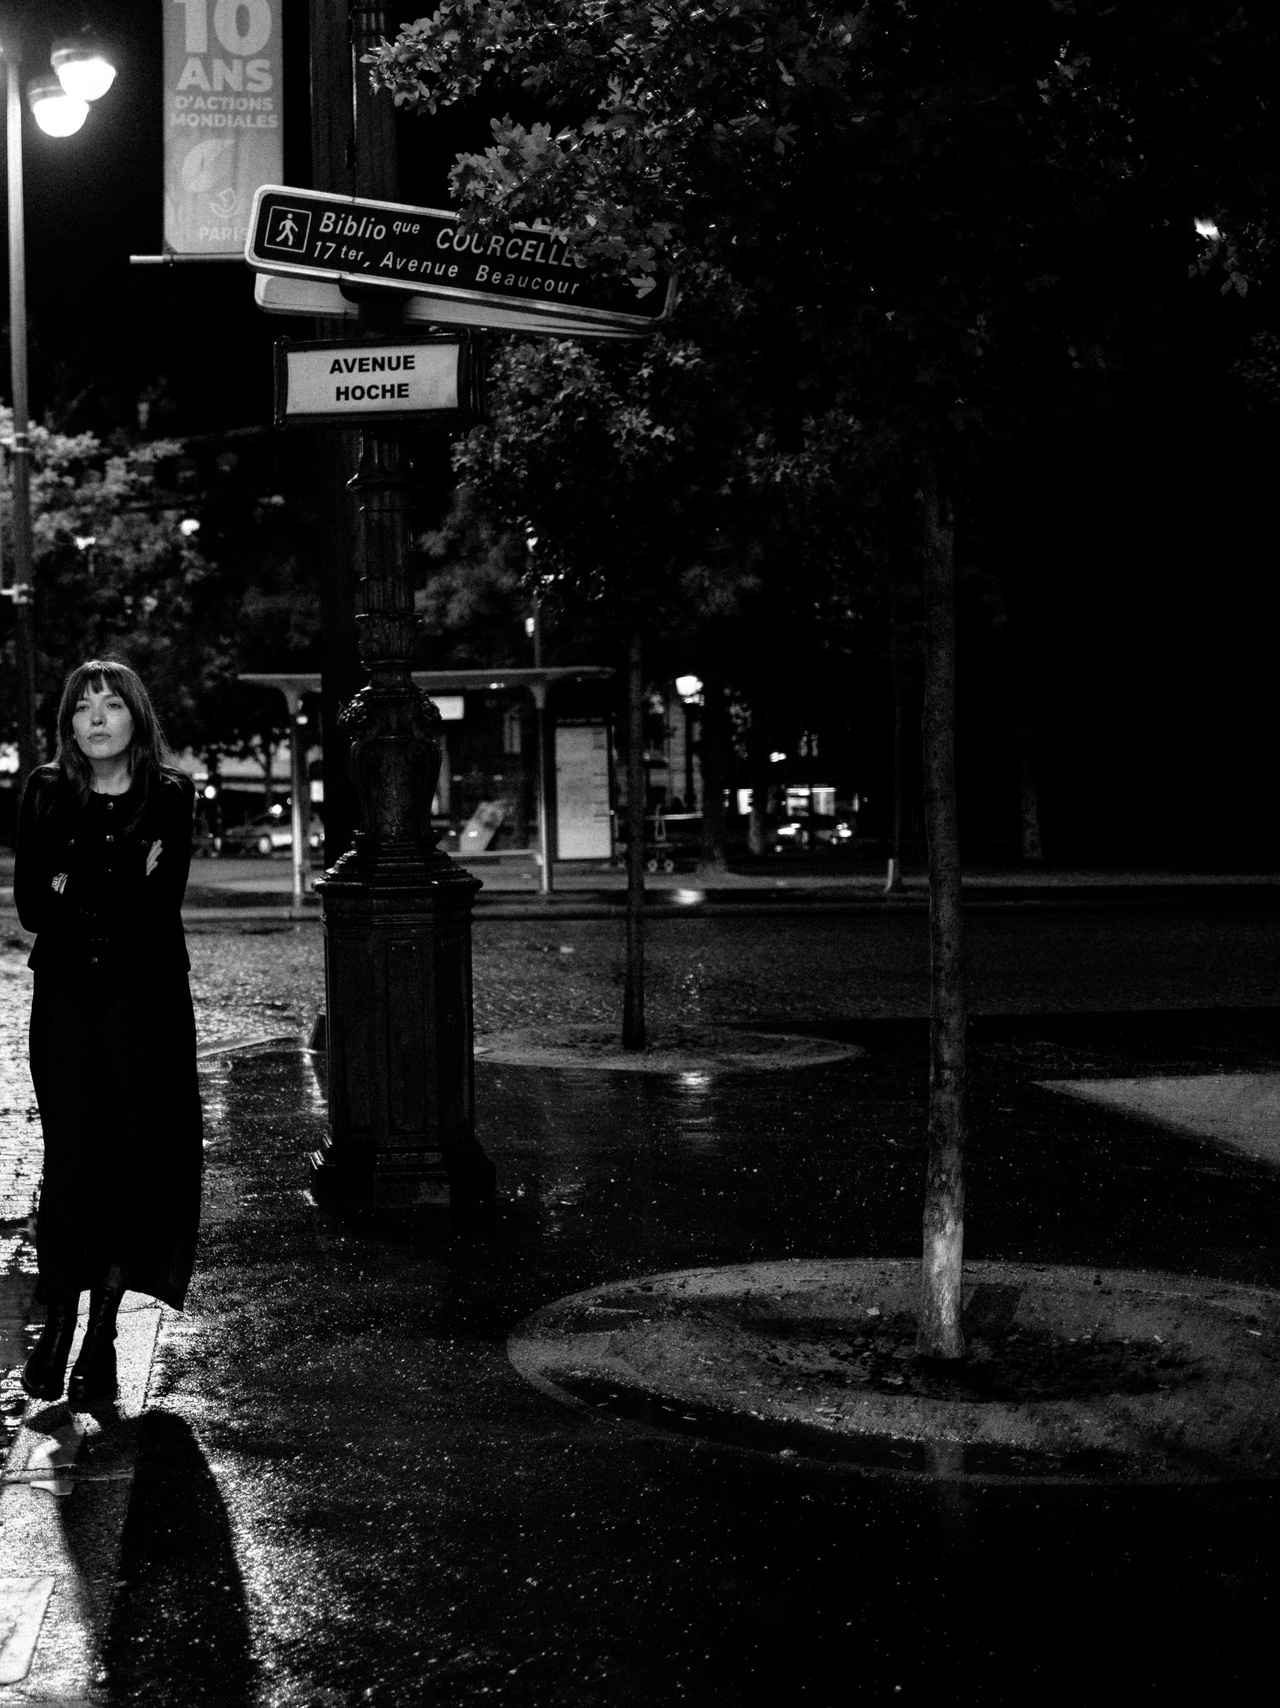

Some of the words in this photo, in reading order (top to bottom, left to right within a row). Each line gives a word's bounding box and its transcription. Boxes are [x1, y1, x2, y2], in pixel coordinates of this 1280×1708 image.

[171, 0, 271, 56] 10
[176, 57, 274, 93] ANS
[174, 96, 274, 112] D'ACTIONS
[170, 113, 279, 129] MONDIALES
[319, 211, 386, 240] Biblio
[392, 221, 421, 236] que
[313, 241, 336, 260] 17
[340, 245, 371, 268] ter,
[379, 251, 459, 278] Avenue
[475, 264, 580, 295] Beaucour
[329, 354, 416, 375] AVENUE
[335, 382, 410, 402] HOCHE
